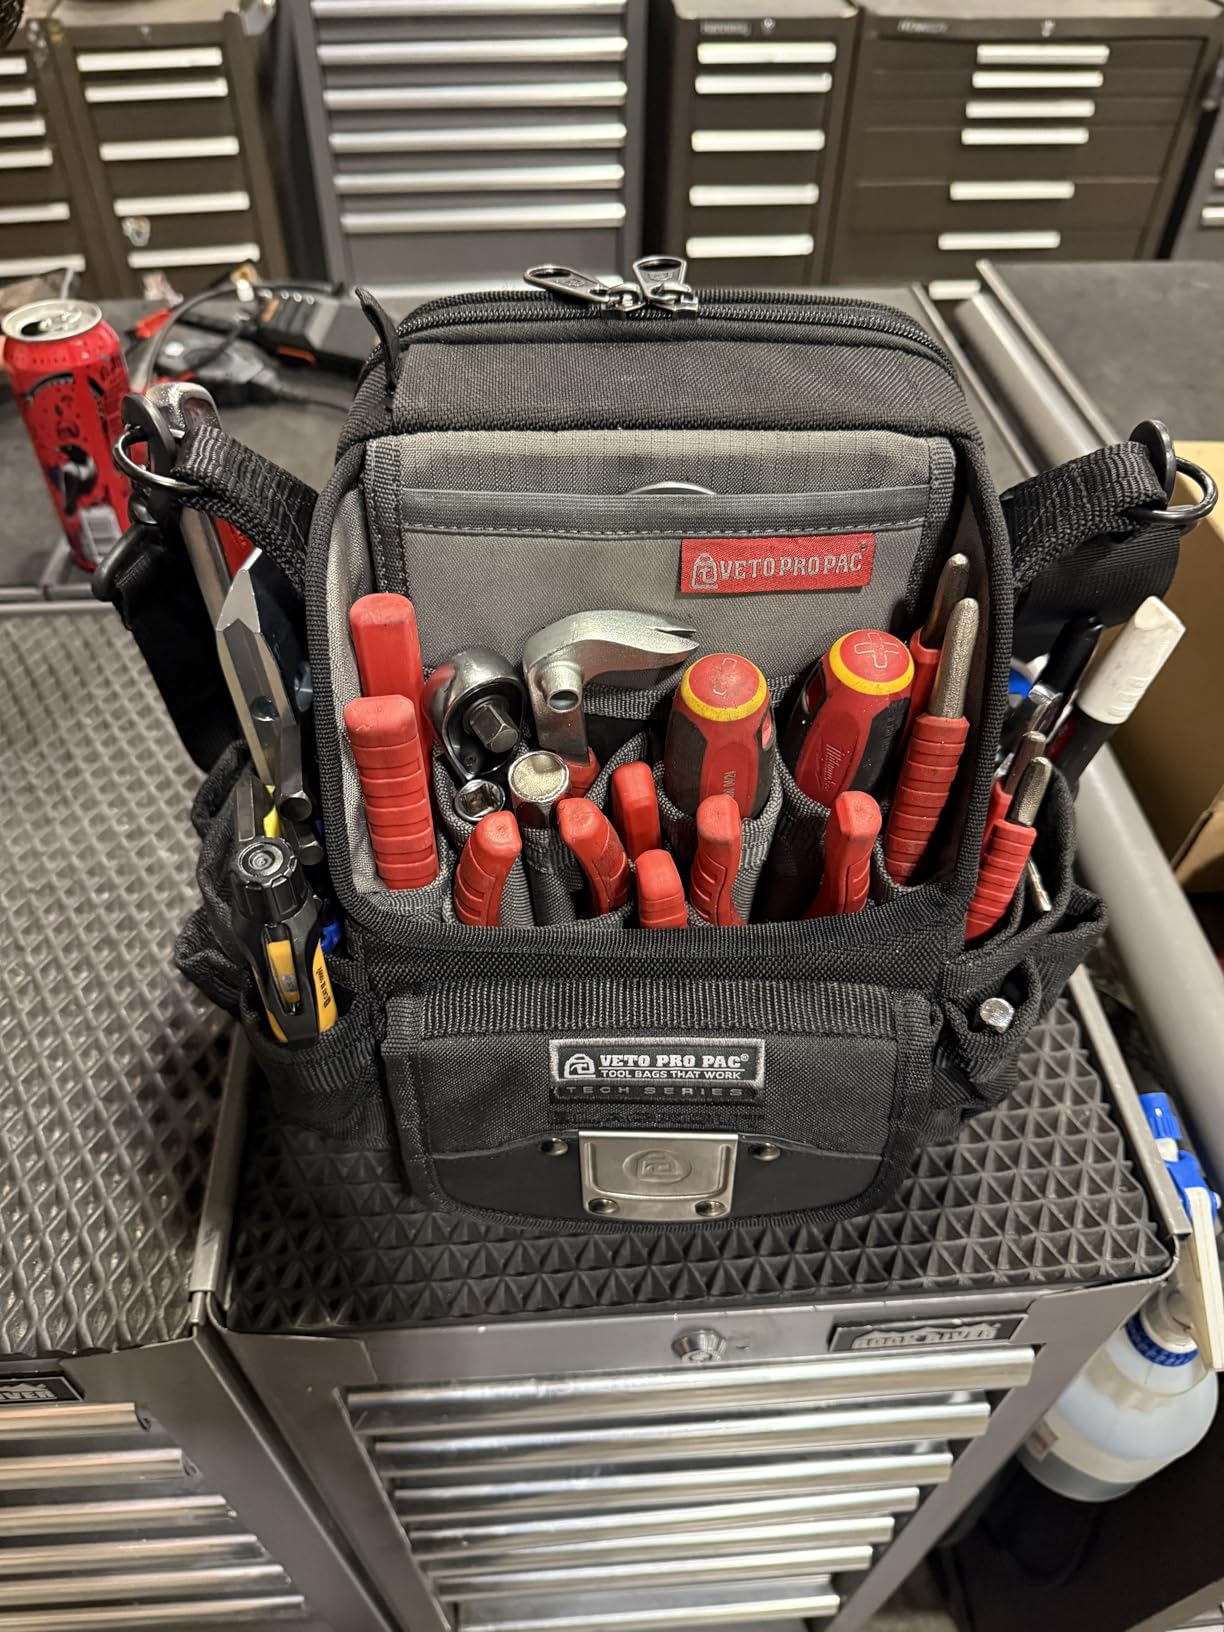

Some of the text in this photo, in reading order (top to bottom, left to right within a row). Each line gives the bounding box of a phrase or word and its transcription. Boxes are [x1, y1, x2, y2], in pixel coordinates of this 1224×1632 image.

[719, 557, 776, 580] VETO
[779, 555, 820, 578] PRO
[599, 1054, 651, 1068] VETO
[656, 1054, 696, 1068] PRO
[601, 1070, 742, 1080] TOOL BAGS THAT WORK
[566, 1086, 744, 1096] TECH SERIES
